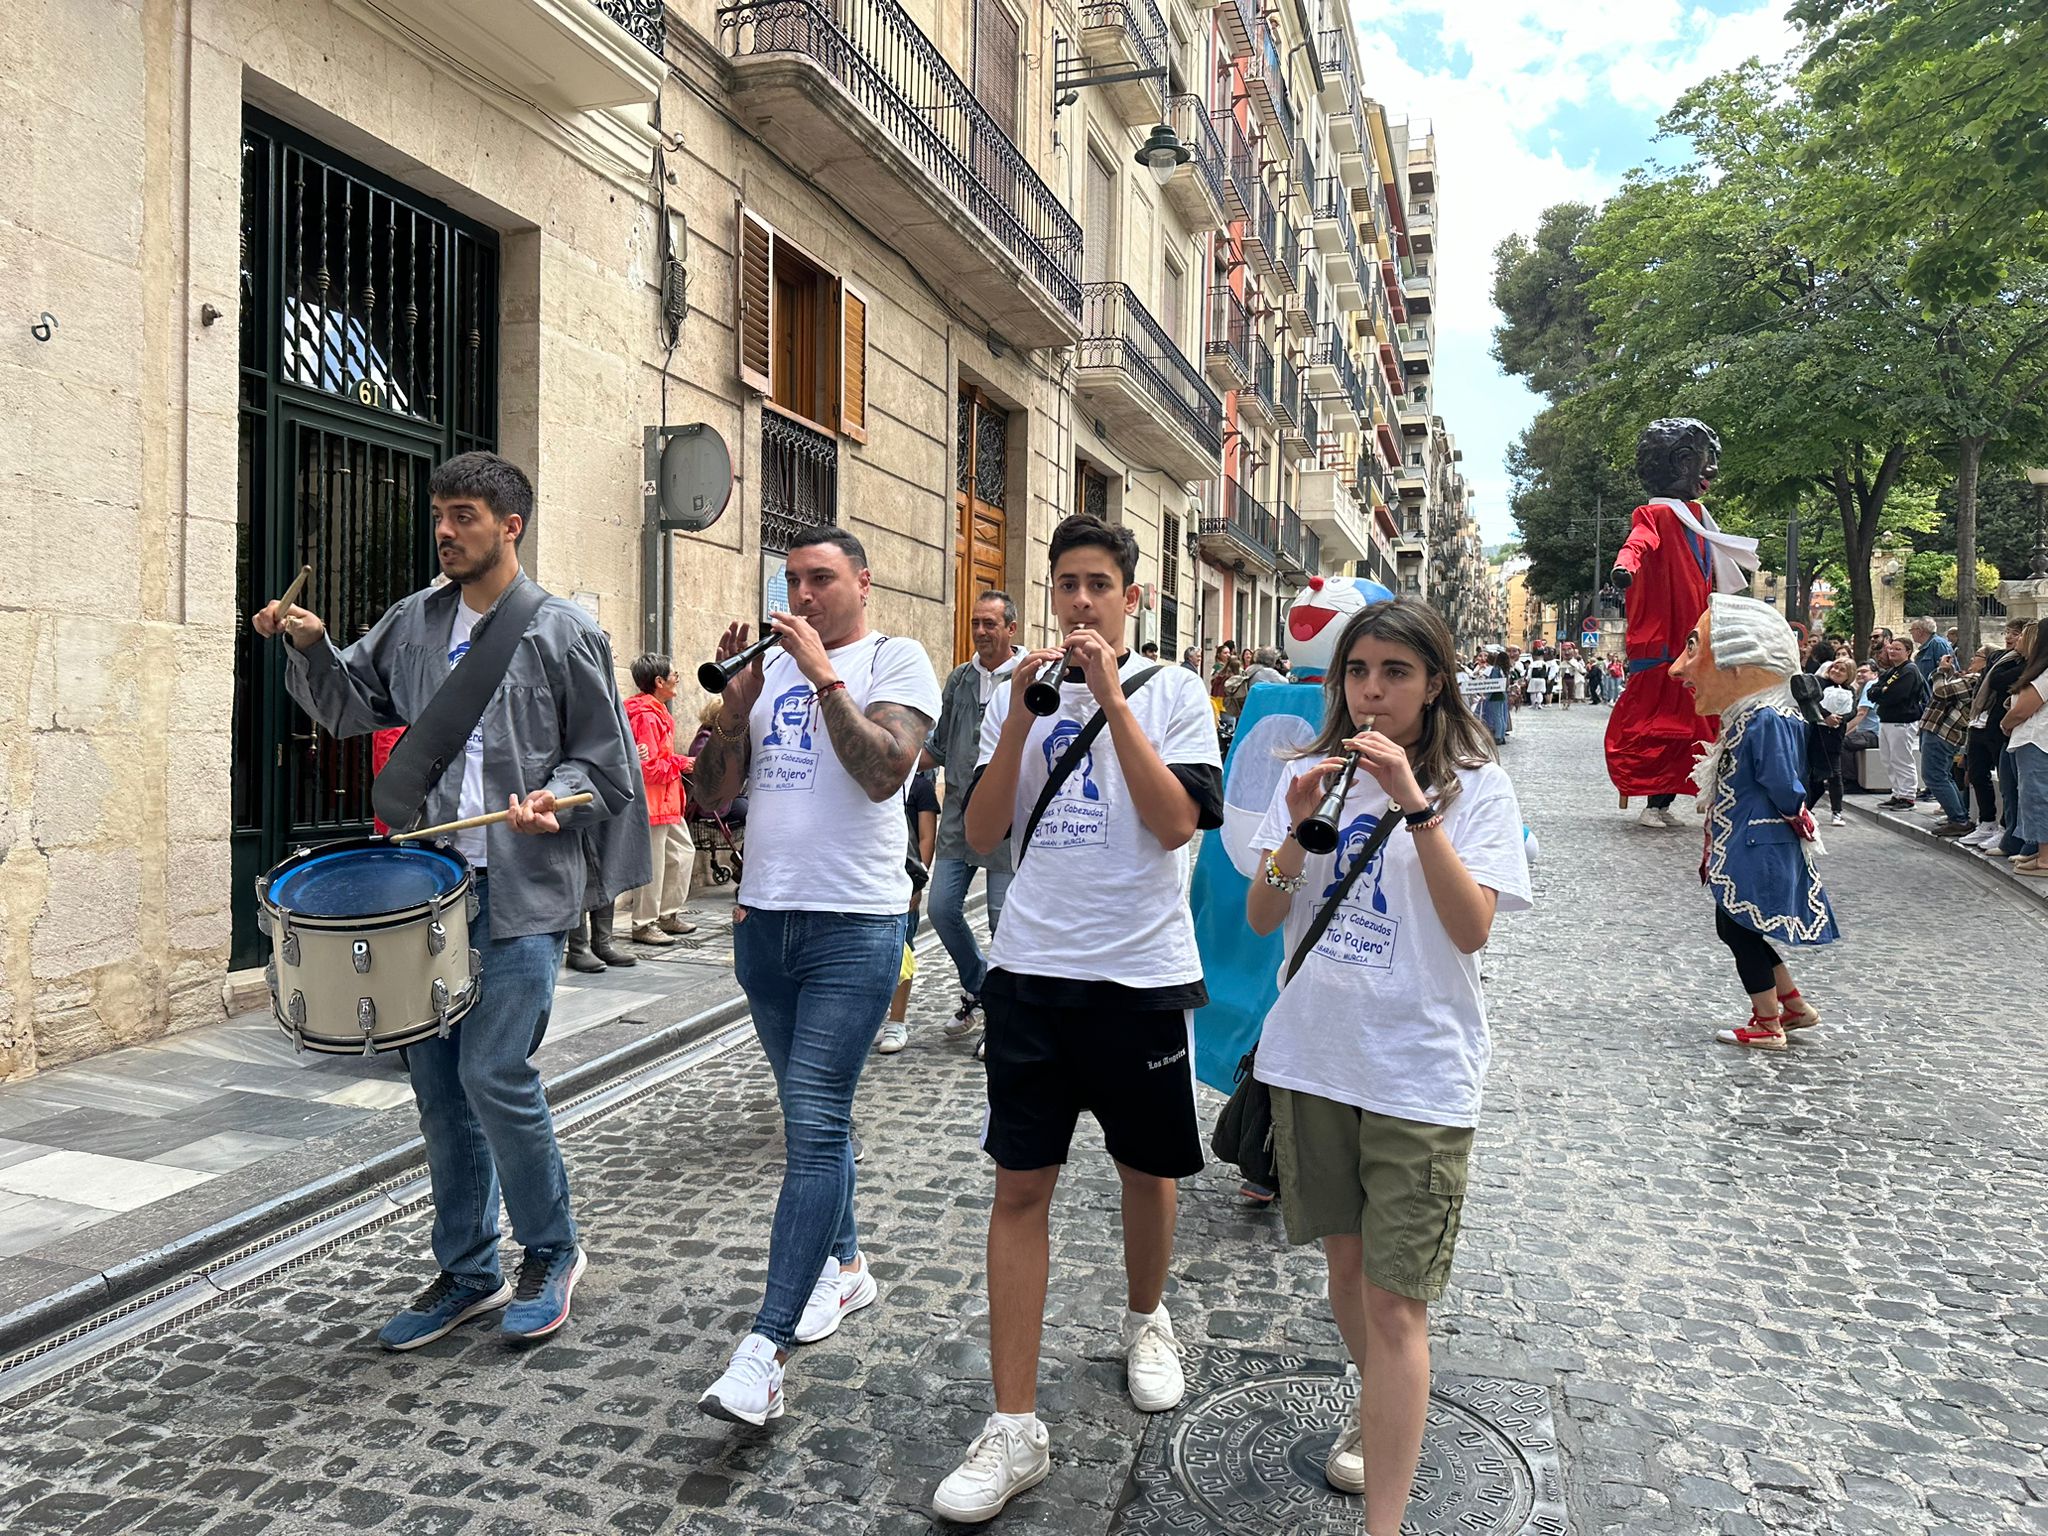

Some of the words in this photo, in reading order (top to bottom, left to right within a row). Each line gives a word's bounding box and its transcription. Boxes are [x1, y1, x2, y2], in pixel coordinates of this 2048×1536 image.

[359, 381, 379, 407] 61
[781, 753, 814, 765] Cabezudos
[1057, 807, 1062, 816] y
[1064, 803, 1104, 817] Cabezudos
[1045, 821, 1058, 835] Tío
[1341, 913, 1347, 924] y
[1350, 913, 1392, 937] Cabezudos
[1327, 927, 1341, 943] Tío
[1343, 953, 1368, 963] MURCIA
[1147, 1061, 1162, 1070] Los
